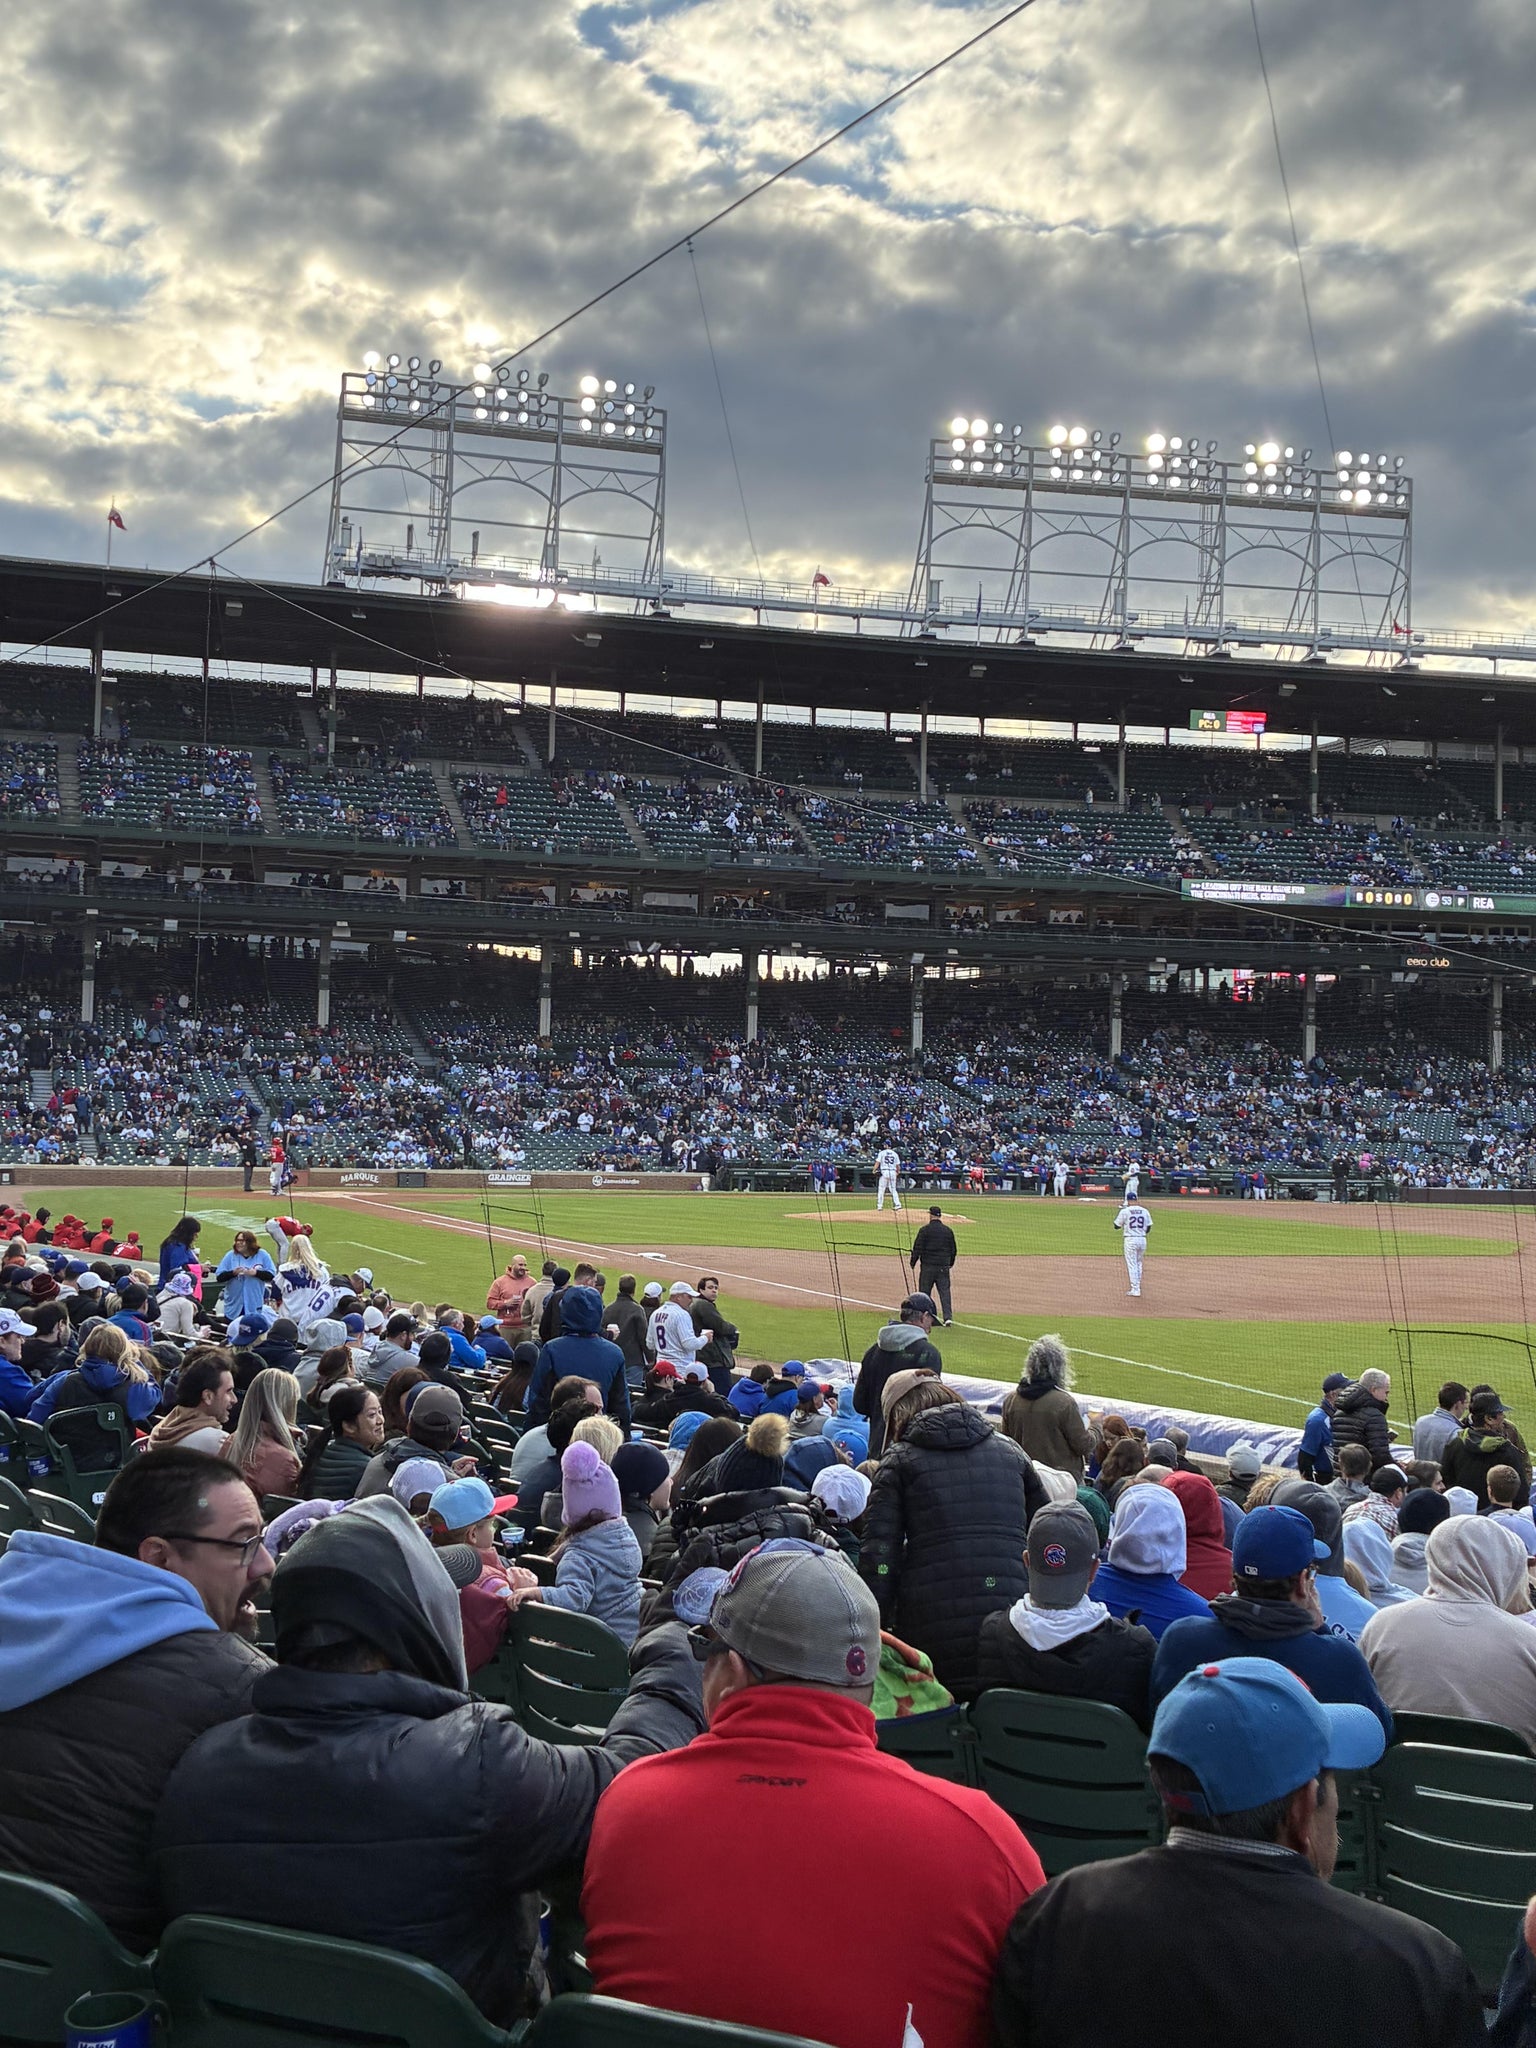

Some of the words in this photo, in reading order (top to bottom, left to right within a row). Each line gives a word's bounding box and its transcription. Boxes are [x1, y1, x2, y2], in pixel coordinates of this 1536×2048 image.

[1356, 892, 1363, 902] B
[1375, 893, 1383, 902] S
[1441, 896, 1452, 905] 53
[1457, 897, 1465, 906] P
[1473, 897, 1494, 909] REA
[1406, 957, 1428, 967] eero
[1429, 957, 1450, 968] club
[884, 1155, 895, 1164] 53
[340, 1172, 380, 1184] MARQUEE
[488, 1174, 532, 1182] GRAINGER
[1129, 1216, 1145, 1229] 29
[308, 1288, 331, 1312] 16
[656, 1325, 667, 1350] 8
